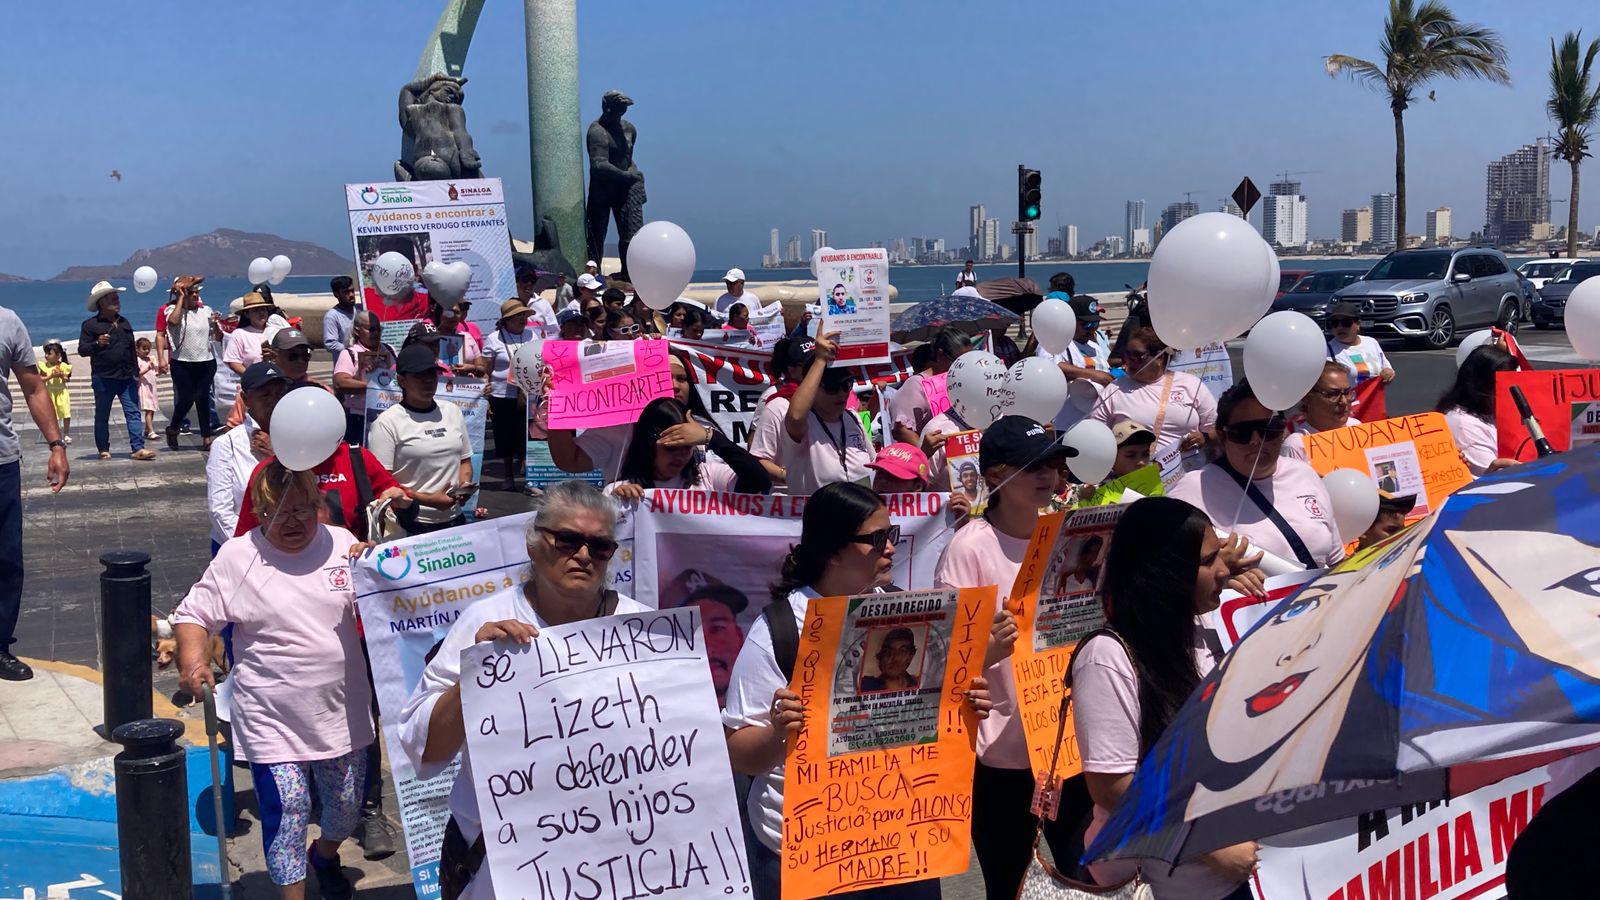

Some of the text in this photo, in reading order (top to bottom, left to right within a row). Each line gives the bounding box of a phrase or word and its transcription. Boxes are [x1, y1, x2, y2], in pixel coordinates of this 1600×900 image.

[382, 195, 412, 204] Sinaloa
[358, 218, 504, 234] KEVIN ERNESTO VERDUGO CERVANTES
[368, 211, 422, 224] Ayúdanos
[435, 208, 484, 219] encontrar
[550, 370, 674, 414] ENCONTRARTE
[956, 434, 970, 444] TE
[1310, 414, 1443, 460] AYUDAME
[650, 489, 764, 516] AYUDANOS
[770, 496, 784, 515] A
[417, 552, 476, 574] Sinaloa
[392, 580, 496, 612] Ayúdanos
[860, 599, 942, 618] DESAPARECIDO
[390, 612, 450, 633] MARTÍN
[809, 604, 824, 642] LOS
[534, 611, 694, 678] LLEVARON
[480, 672, 662, 748] a Lizeth
[488, 727, 698, 820] por defender
[798, 746, 940, 784] MI FAMILIA ME
[822, 773, 910, 812] BUSCA
[498, 822, 518, 844] a
[608, 782, 696, 845] hijos
[873, 807, 905, 830] para
[788, 827, 950, 870] SU HERMANO Y SU
[419, 868, 430, 880] Si
